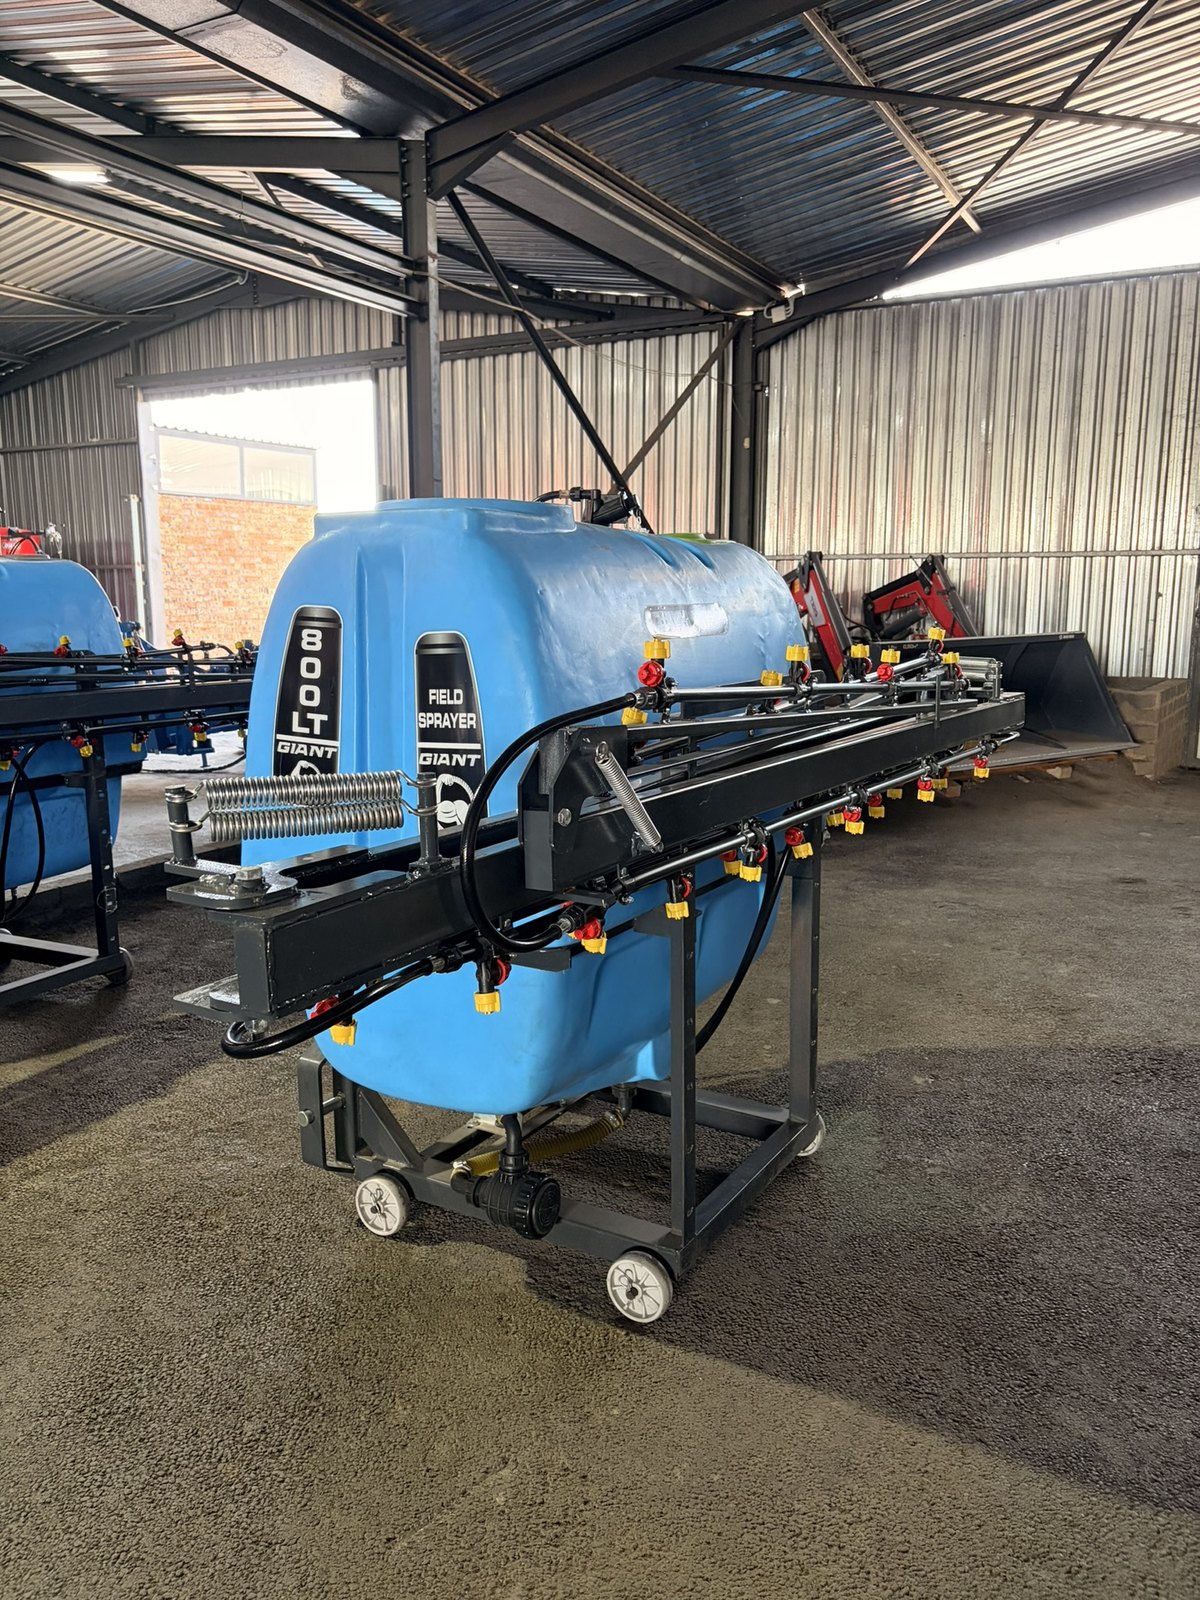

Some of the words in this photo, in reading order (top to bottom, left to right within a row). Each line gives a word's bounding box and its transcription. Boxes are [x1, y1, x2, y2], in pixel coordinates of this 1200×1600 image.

[300, 629, 322, 707] 800
[428, 689, 463, 705] FIELD
[291, 712, 328, 735] LT
[418, 713, 476, 729] SPRAYER
[276, 742, 337, 759] GIANT
[418, 753, 481, 767] GIANT
